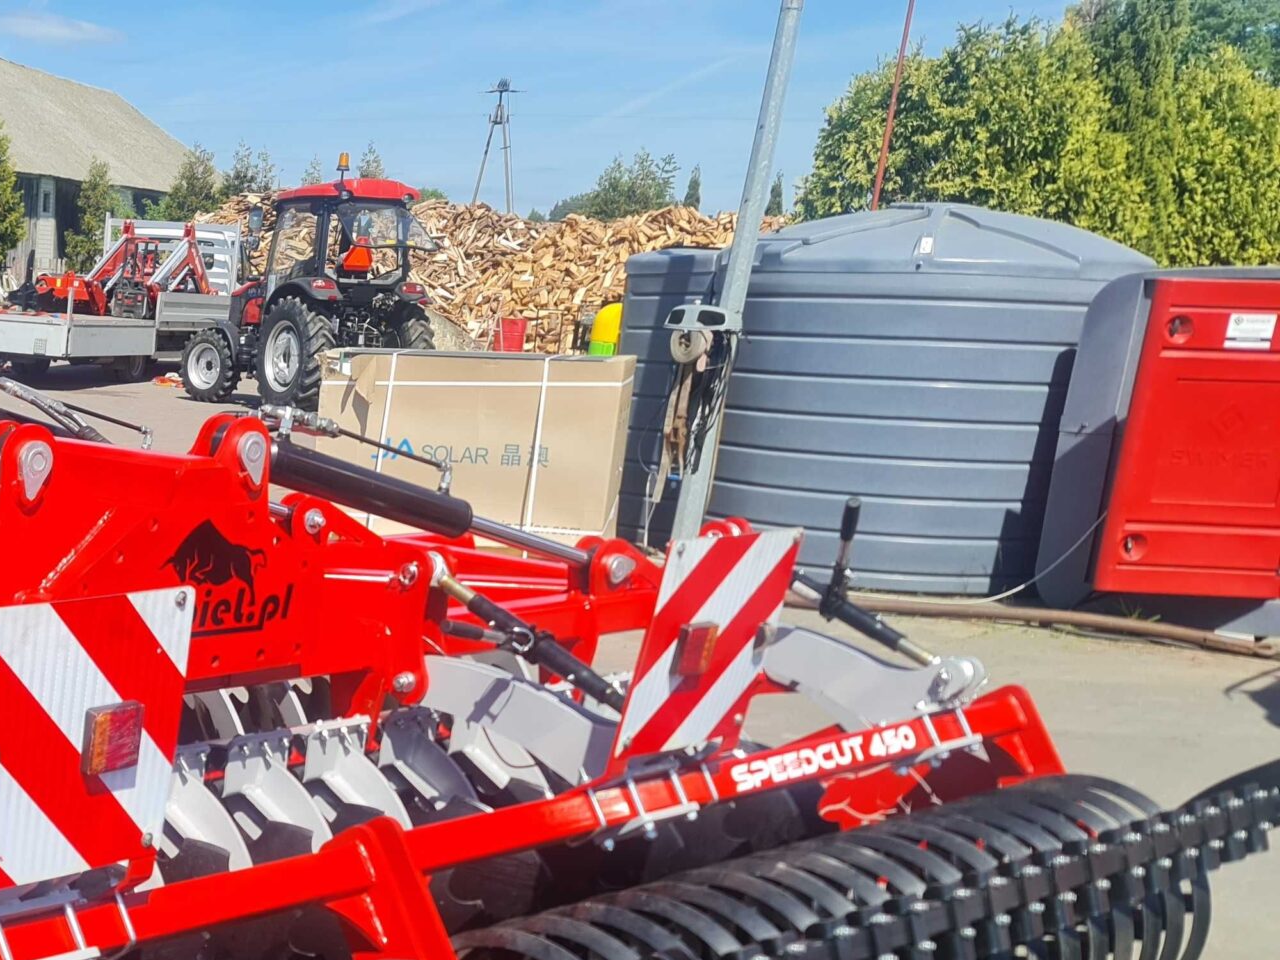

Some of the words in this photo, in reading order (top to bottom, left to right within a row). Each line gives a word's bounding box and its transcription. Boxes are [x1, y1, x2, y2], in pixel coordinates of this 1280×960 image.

[422, 444, 488, 465] SOLAR
[194, 583, 294, 631] iel.pl
[731, 735, 864, 792] SPEEDCUT
[870, 725, 917, 757] 450
